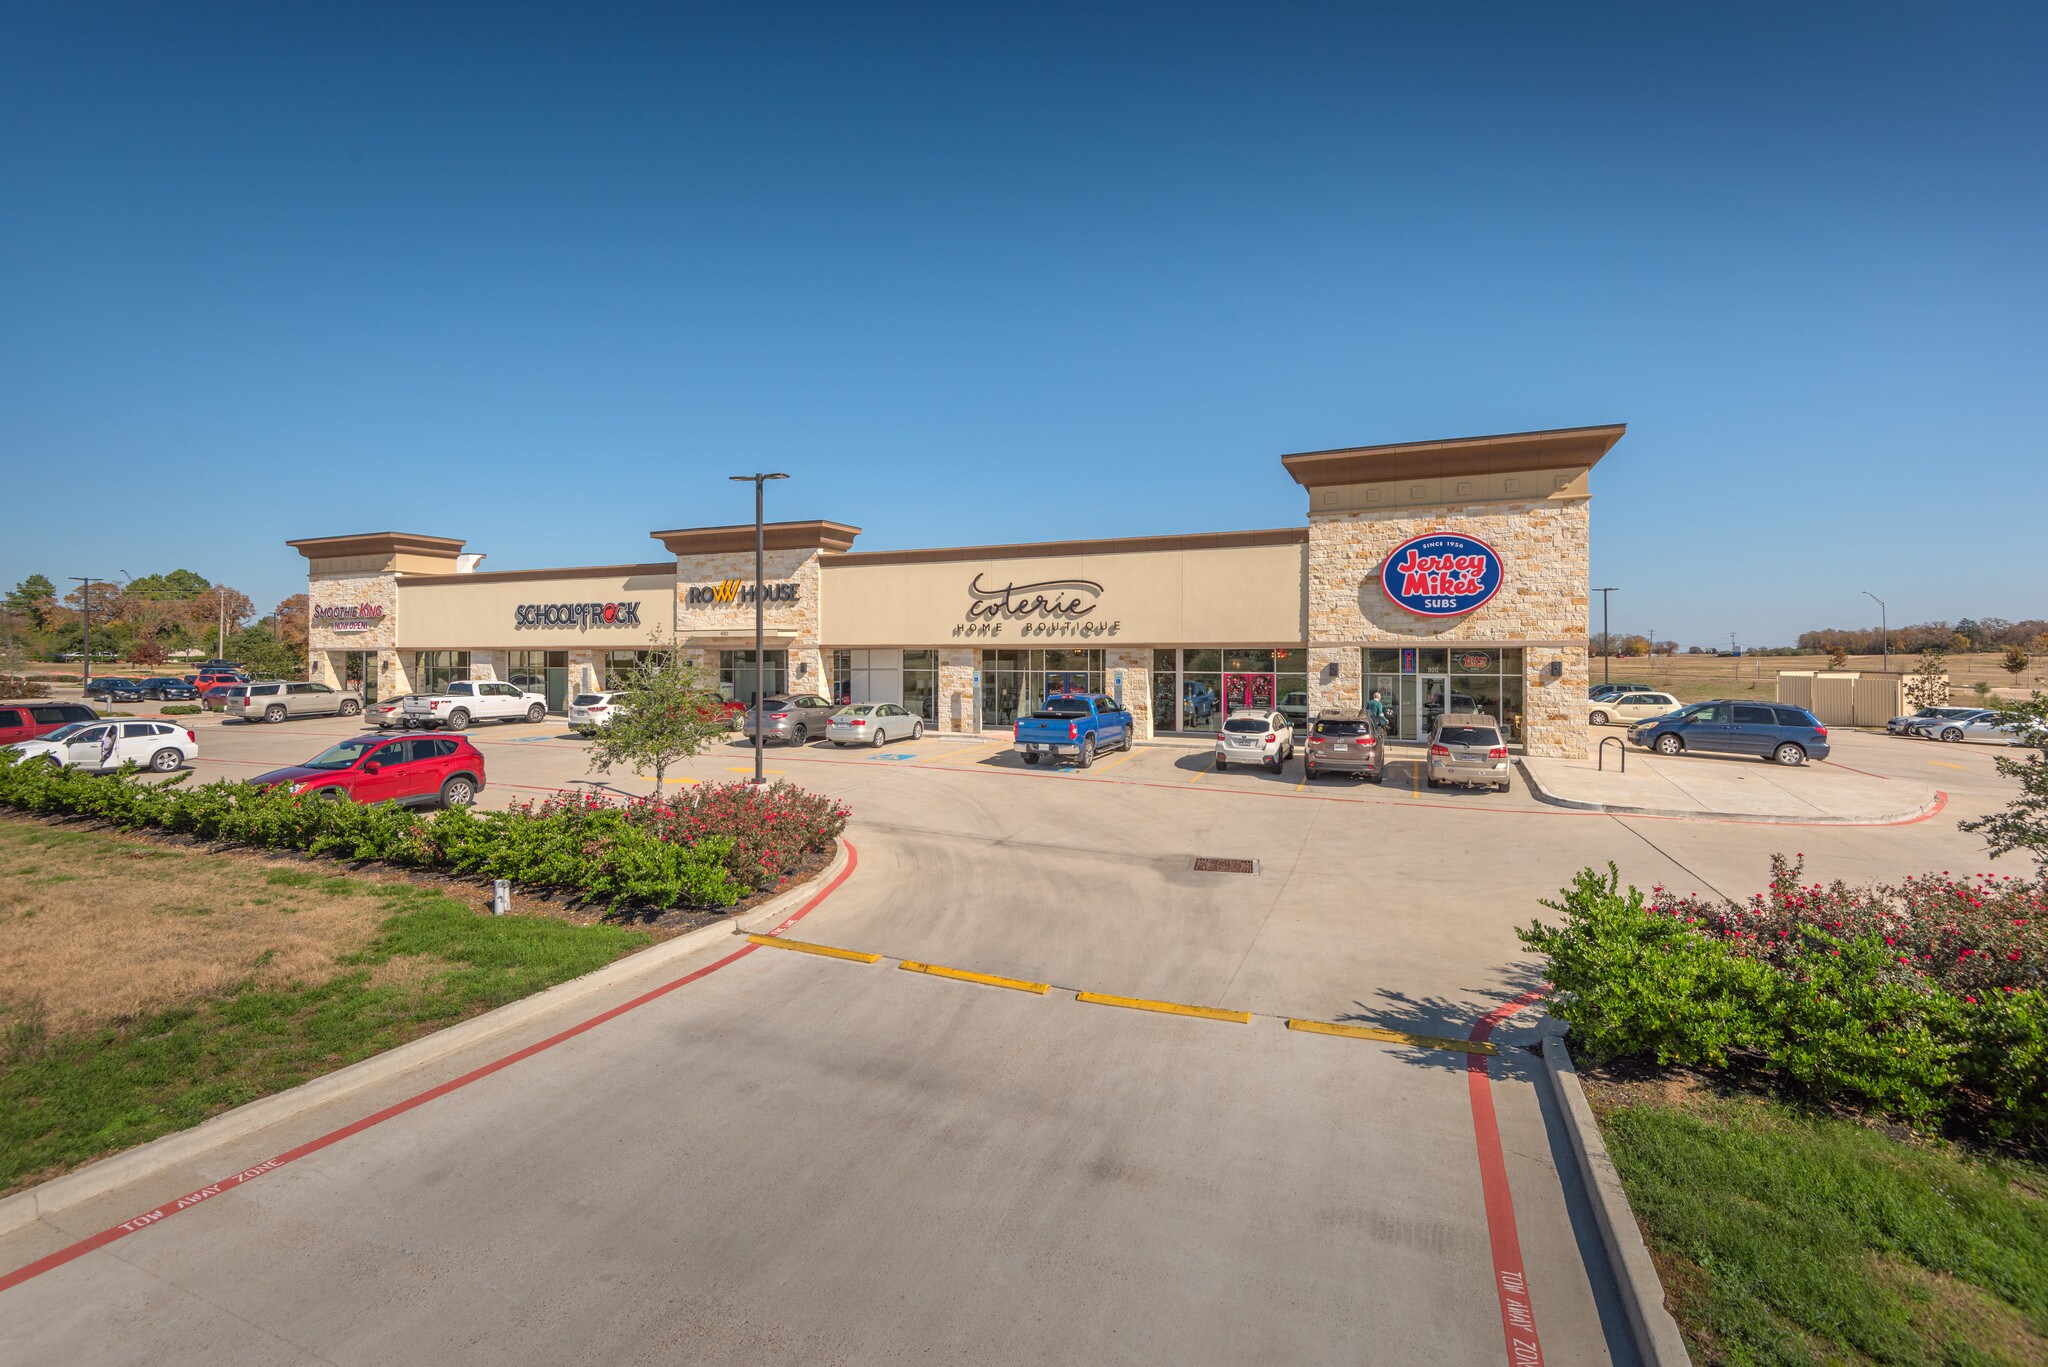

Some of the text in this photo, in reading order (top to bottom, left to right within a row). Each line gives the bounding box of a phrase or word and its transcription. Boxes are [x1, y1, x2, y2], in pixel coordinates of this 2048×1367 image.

[1422, 541, 1444, 549] SINCE
[1397, 549, 1486, 578] Jersey
[741, 583, 800, 602] HOUSE
[970, 572, 1104, 617] coterie
[1401, 571, 1485, 597] Mike's
[314, 604, 358, 618] SMOOTHIE
[516, 603, 578, 626] SCHOOL
[590, 601, 641, 625] ROCK
[1424, 599, 1457, 608] SUBS
[335, 621, 348, 630] NOW
[957, 621, 1121, 632] HOME BOUTIQUE
[118, 1158, 285, 1231] TOW AWAY ZONE
[1501, 1270, 1539, 1367] TOW AWAY ZON
